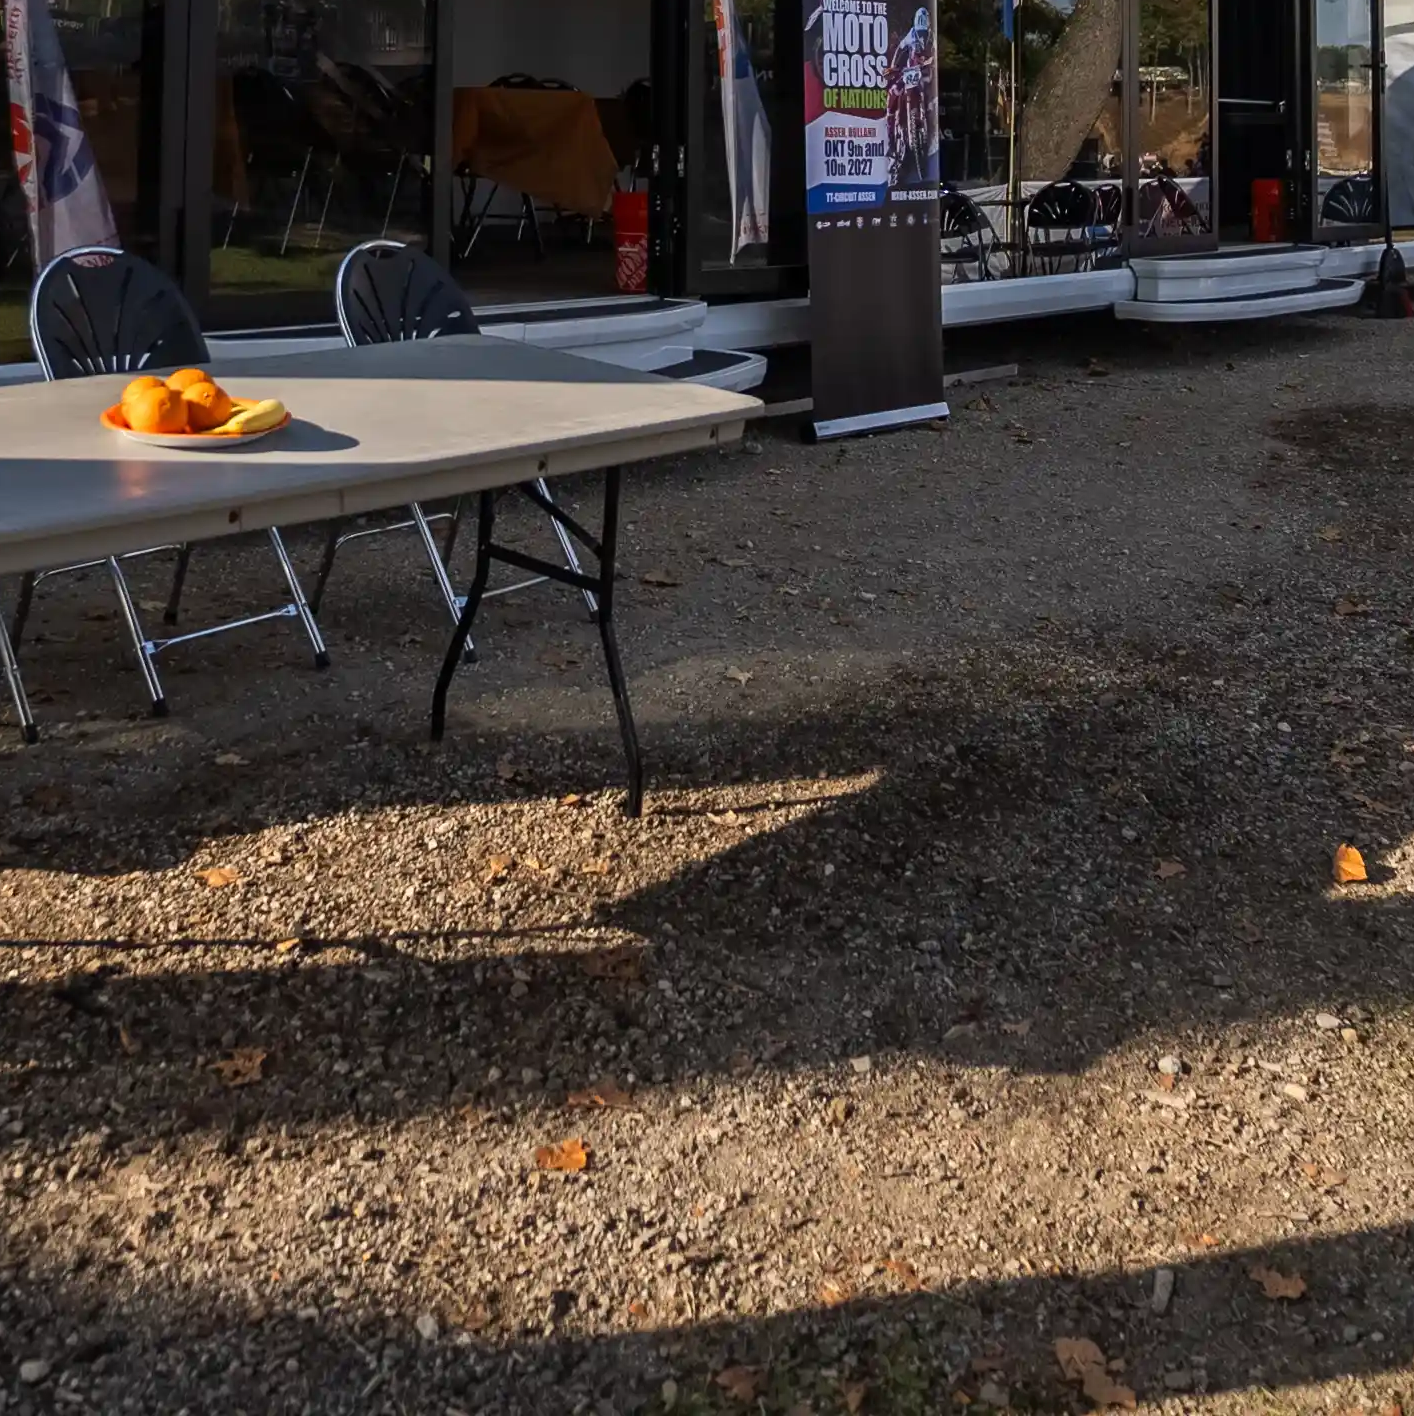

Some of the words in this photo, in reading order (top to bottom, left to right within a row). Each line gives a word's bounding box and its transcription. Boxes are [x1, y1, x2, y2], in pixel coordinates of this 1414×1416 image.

[861, 0, 872, 14] TO
[873, 1, 887, 15] THE
[823, 12, 888, 54] MOTO
[823, 52, 888, 88] CROSS
[823, 88, 838, 108] OF
[840, 89, 887, 109] NATIONS
[824, 139, 845, 157] OKT
[848, 140, 863, 157] 9th
[865, 140, 884, 157] and
[824, 159, 846, 176] 10th
[848, 159, 873, 176] 2027
